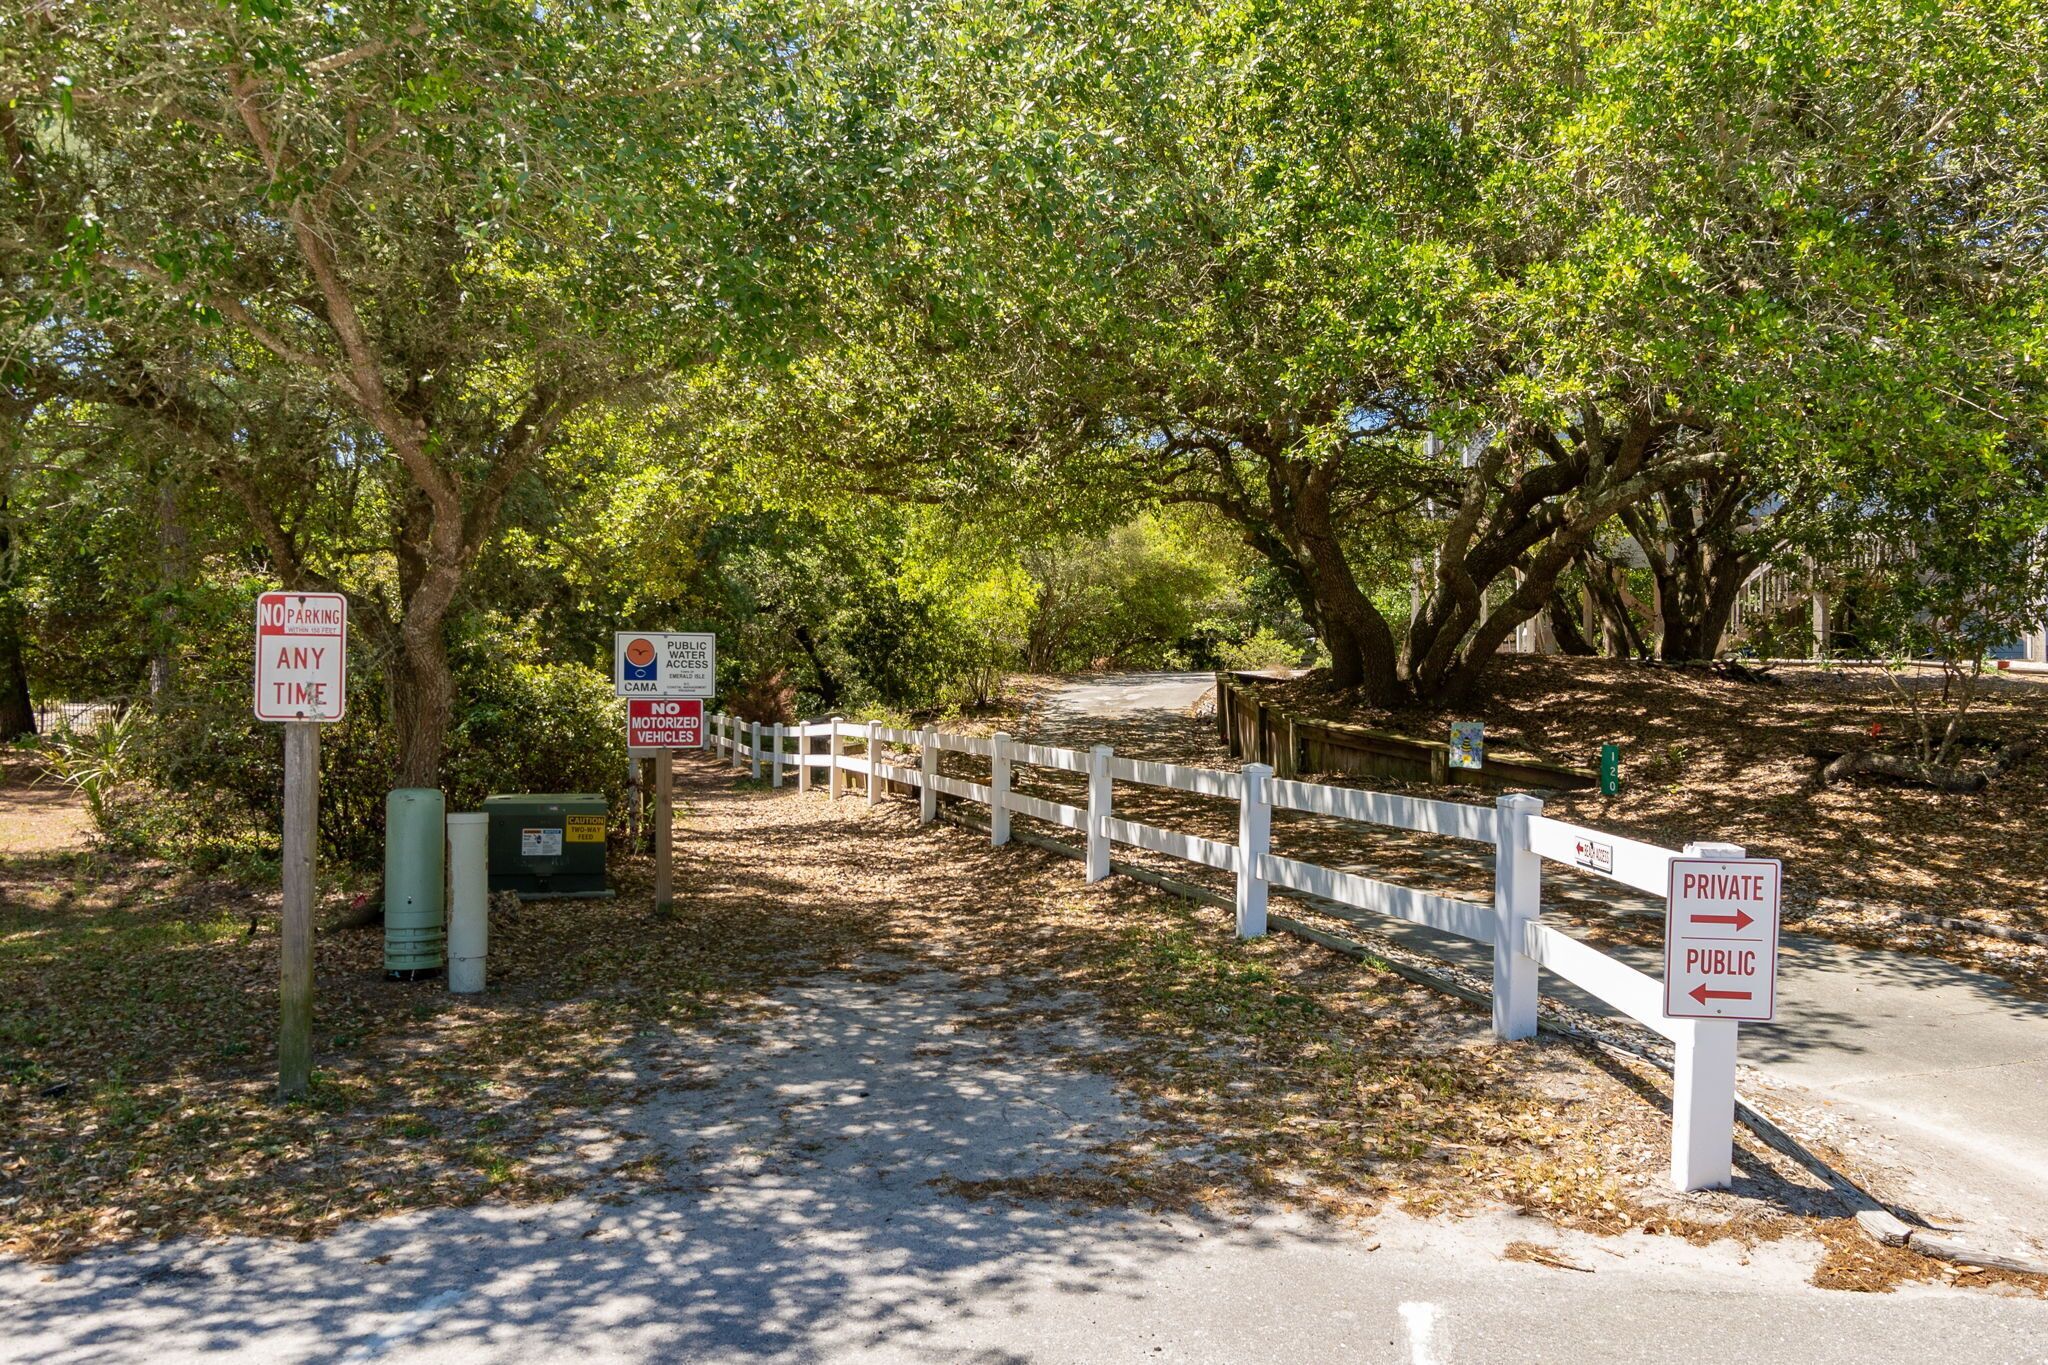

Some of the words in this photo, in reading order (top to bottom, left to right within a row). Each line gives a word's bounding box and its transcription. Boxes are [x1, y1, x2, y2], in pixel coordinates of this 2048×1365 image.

[260, 603, 285, 627] NO
[287, 608, 340, 625] PARKING
[667, 641, 707, 650] PUBLIC
[276, 647, 325, 670] ANY
[669, 651, 706, 660] WATER
[665, 660, 709, 669] ACCESS
[273, 682, 327, 705] TIME
[624, 682, 658, 692] CAMA
[651, 703, 680, 715] NO
[632, 716, 699, 729] MOTORIZED
[637, 730, 694, 743] VEHICLES
[1596, 847, 1610, 864] ACCESS
[1683, 873, 1764, 901] PRIVATE
[1686, 948, 1756, 976] PUBLIC
